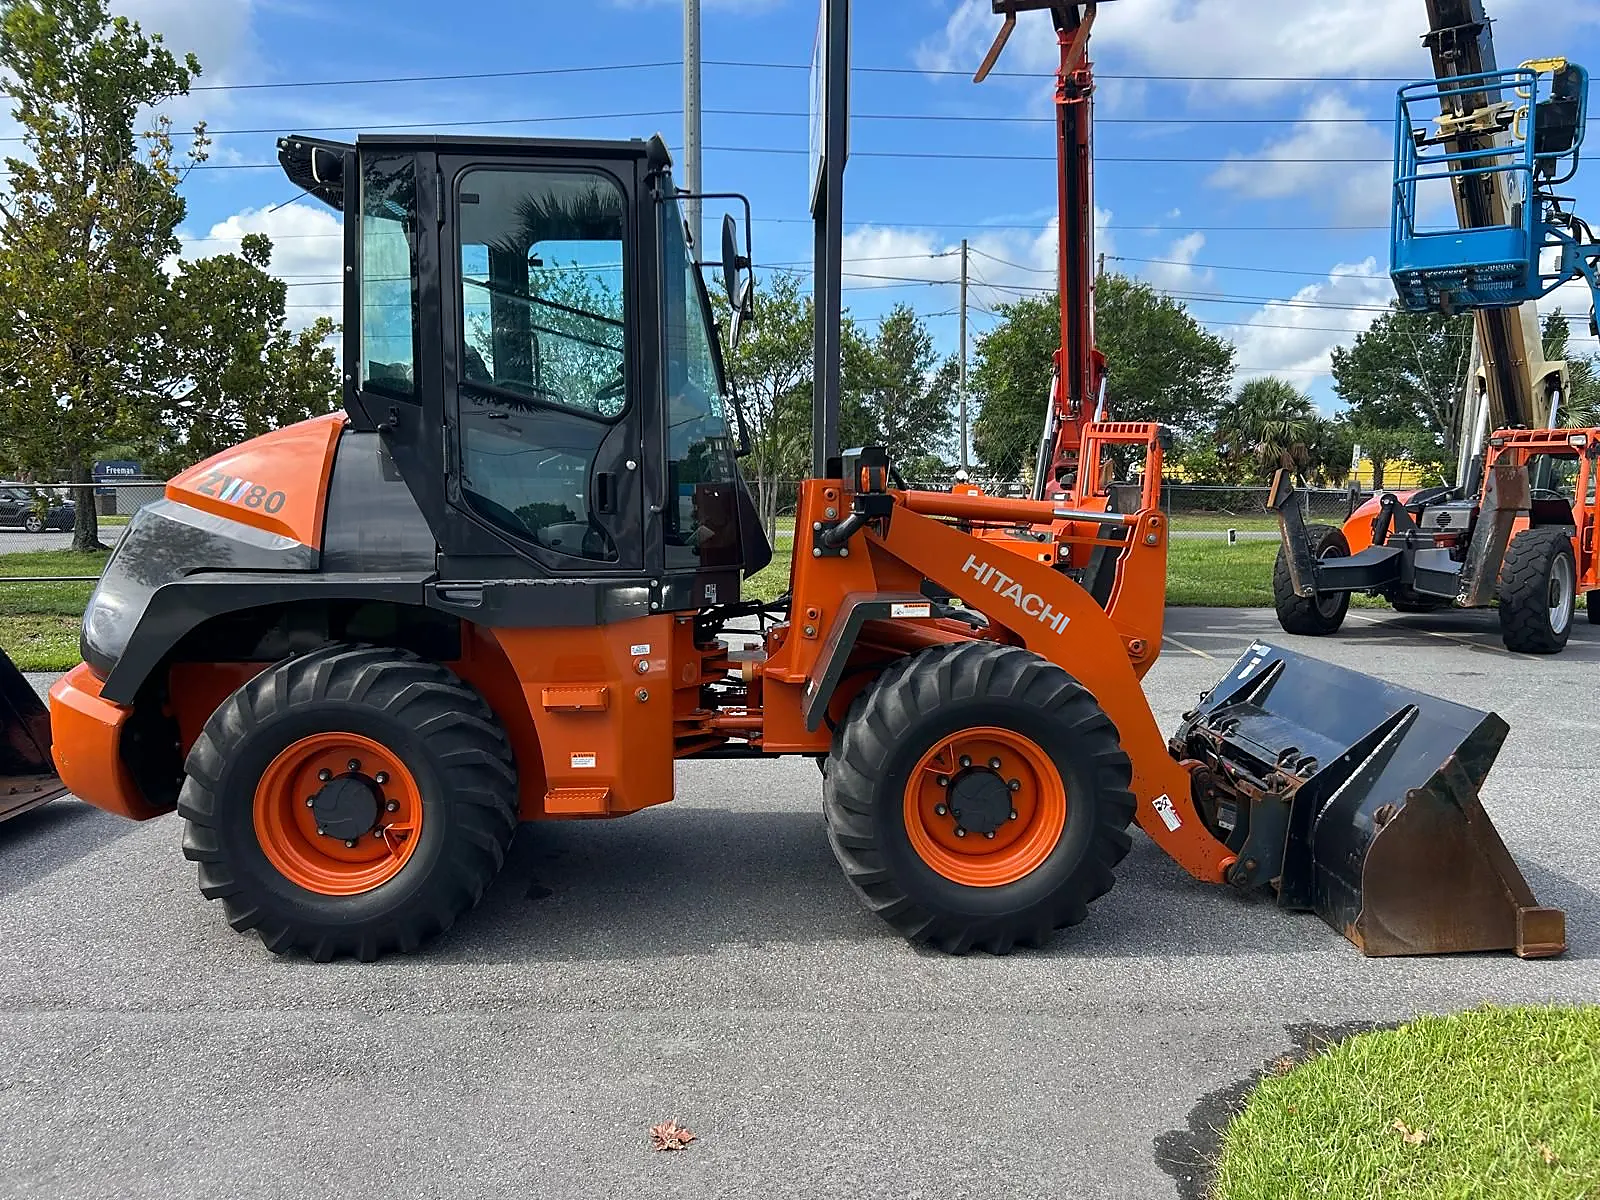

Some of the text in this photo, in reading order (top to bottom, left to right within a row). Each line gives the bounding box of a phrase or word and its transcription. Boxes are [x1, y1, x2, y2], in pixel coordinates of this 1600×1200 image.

[105, 466, 134, 474] Freeman
[197, 471, 286, 513] ZW80
[961, 553, 1071, 635] HITACHI
